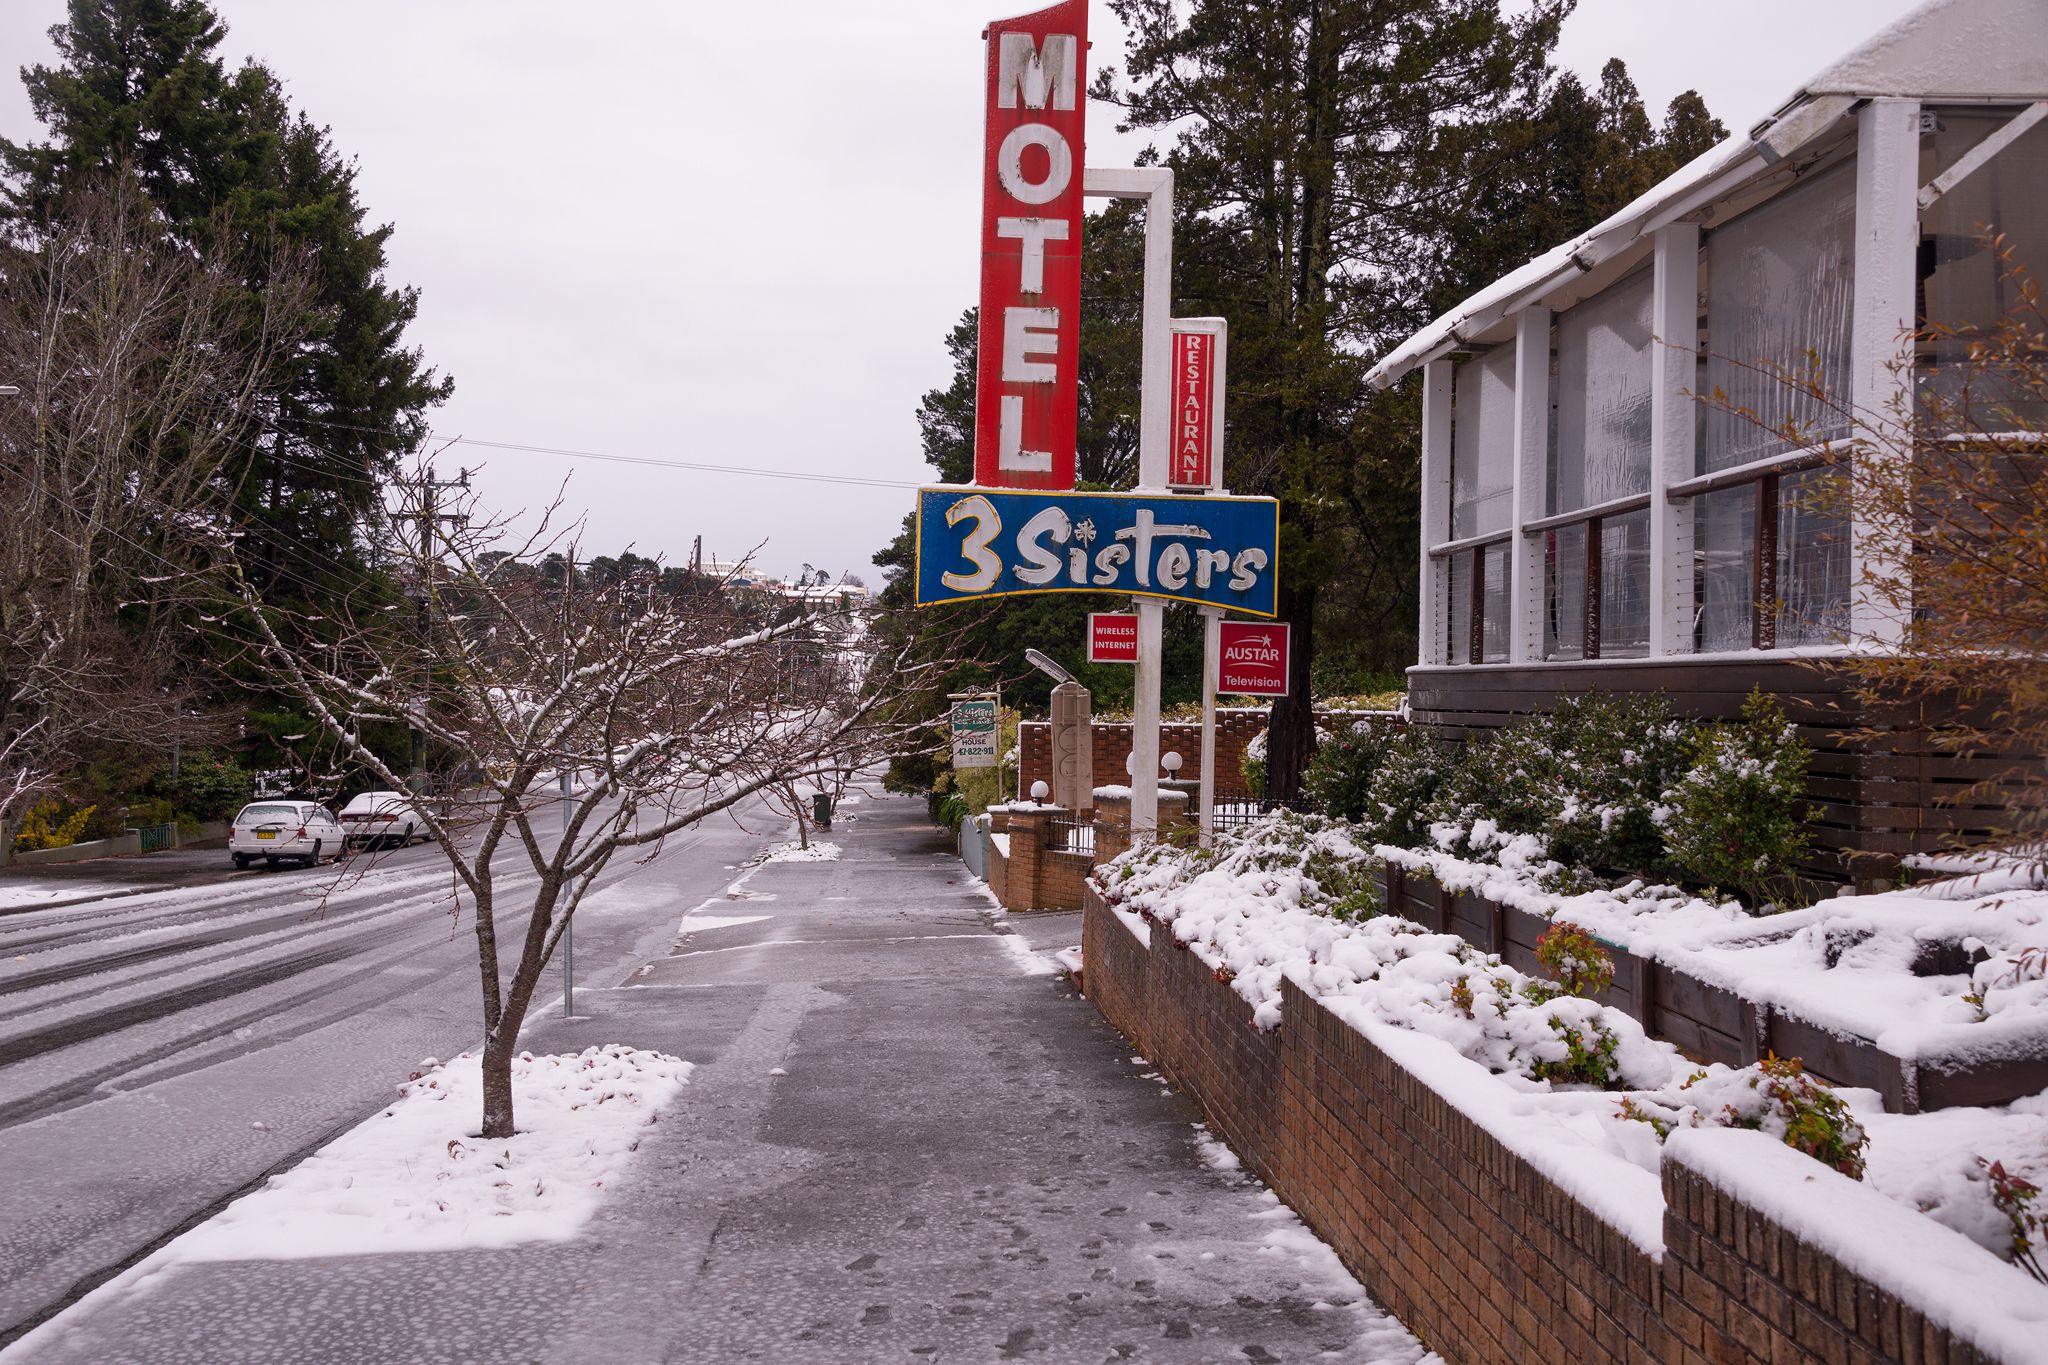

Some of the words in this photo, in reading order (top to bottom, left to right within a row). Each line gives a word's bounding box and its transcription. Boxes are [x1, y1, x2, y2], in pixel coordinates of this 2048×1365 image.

[997, 32, 1077, 472] MOTEL
[1182, 335, 1201, 484] RESTAURANT
[941, 495, 1003, 592] 3
[1012, 506, 1268, 591] Sisters
[1095, 627, 1135, 636] WIRELESS
[1095, 641, 1135, 649] INTERNET
[1224, 647, 1280, 662] AUSTAR
[1224, 675, 1281, 687] Television
